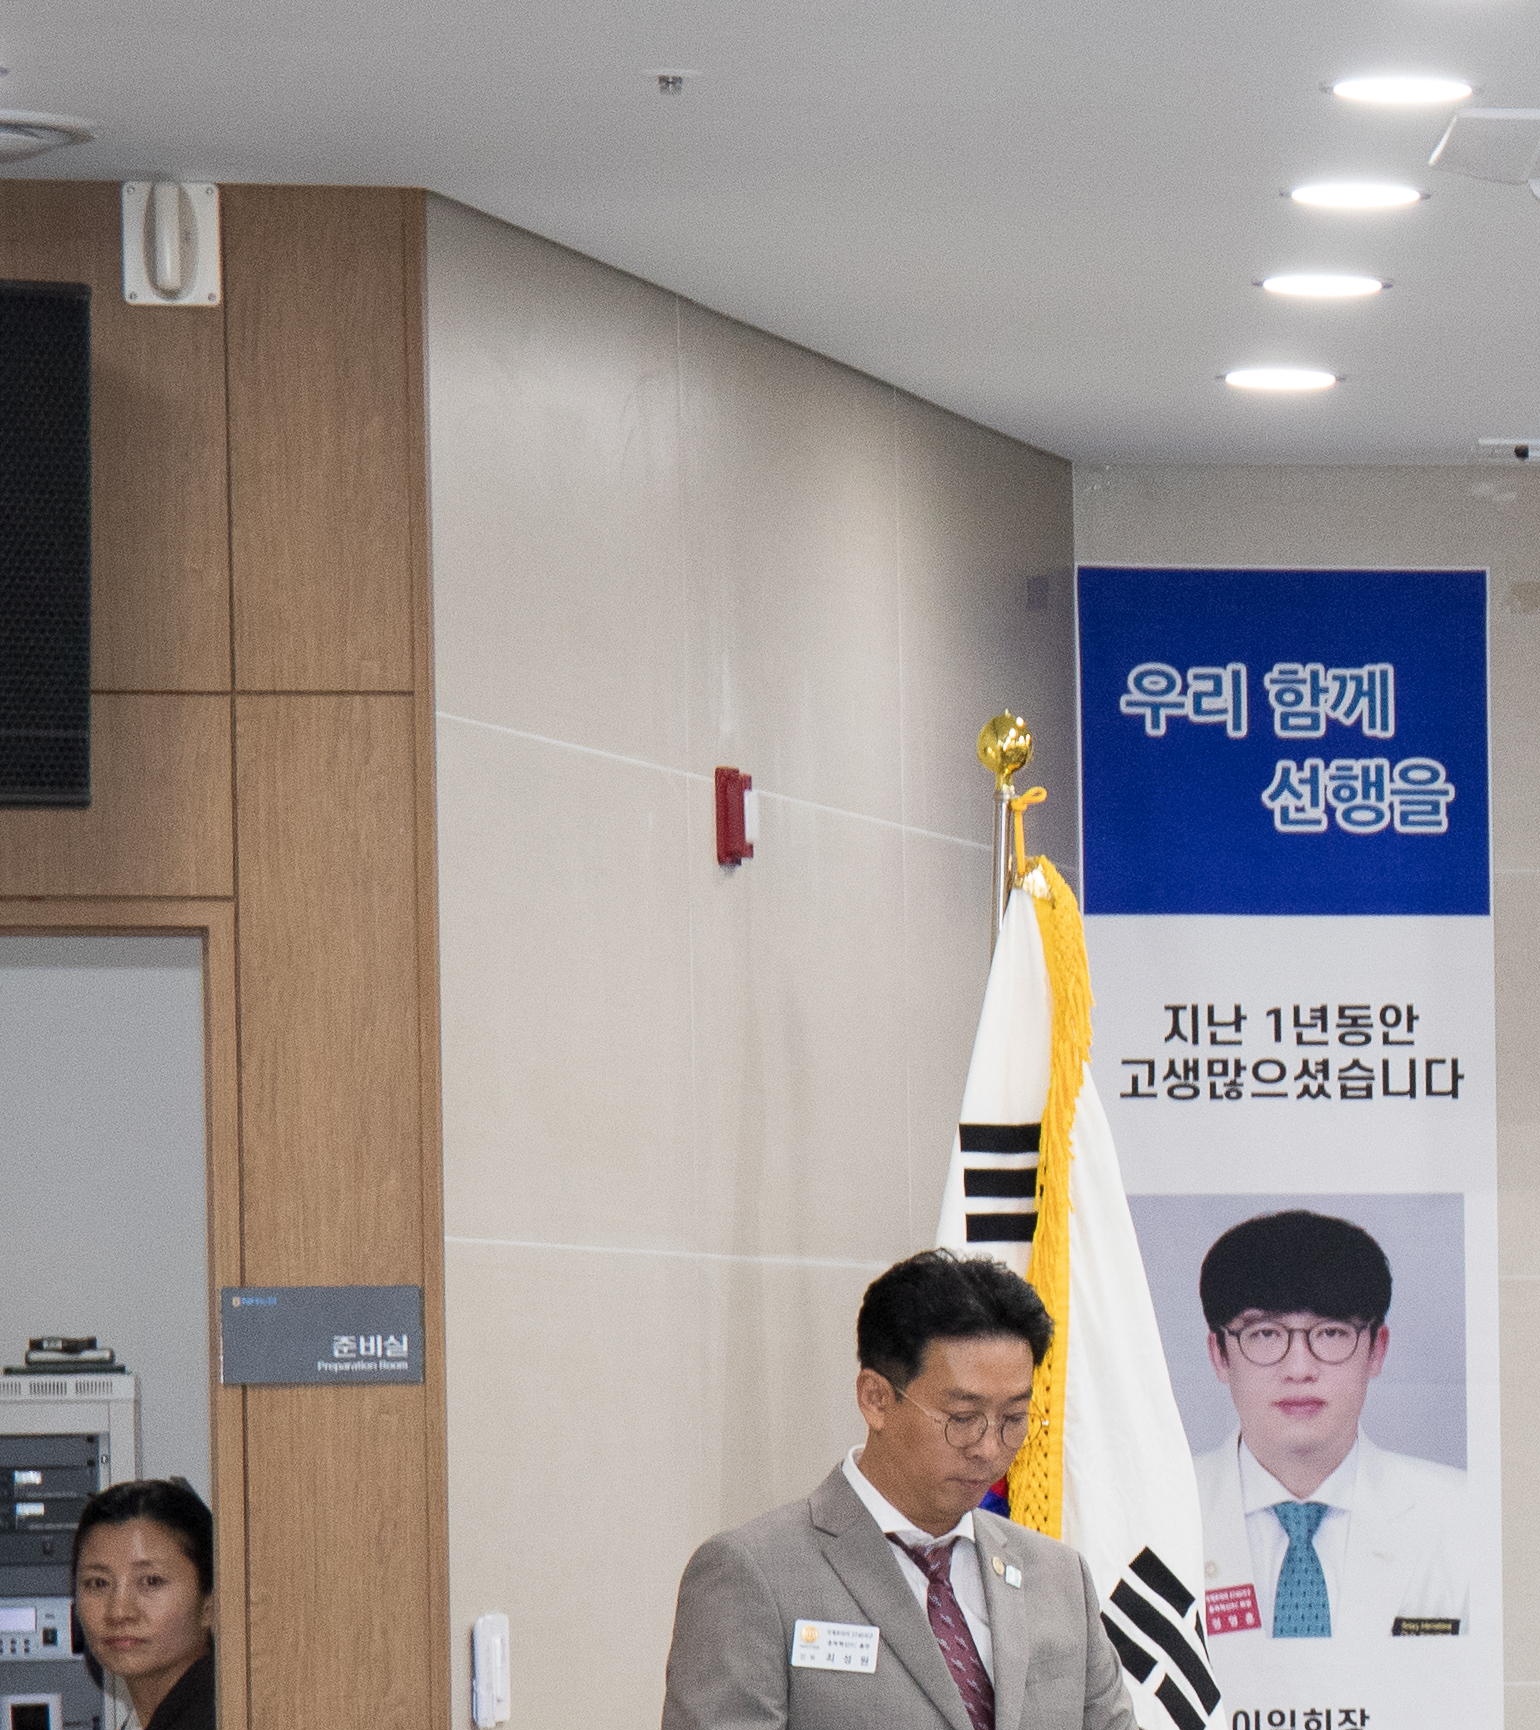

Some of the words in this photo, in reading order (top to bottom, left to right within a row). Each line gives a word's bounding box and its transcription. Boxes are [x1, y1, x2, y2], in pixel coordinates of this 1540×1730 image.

[1121, 663, 1248, 737] 우리
[1264, 663, 1394, 738] 함께
[1263, 758, 1455, 833] 선행을
[1164, 1004, 1247, 1046] 지난
[1266, 1004, 1419, 1047] 1년동안
[1120, 1058, 1464, 1101] 고생많으셨습니다
[333, 1334, 409, 1359] 준비실
